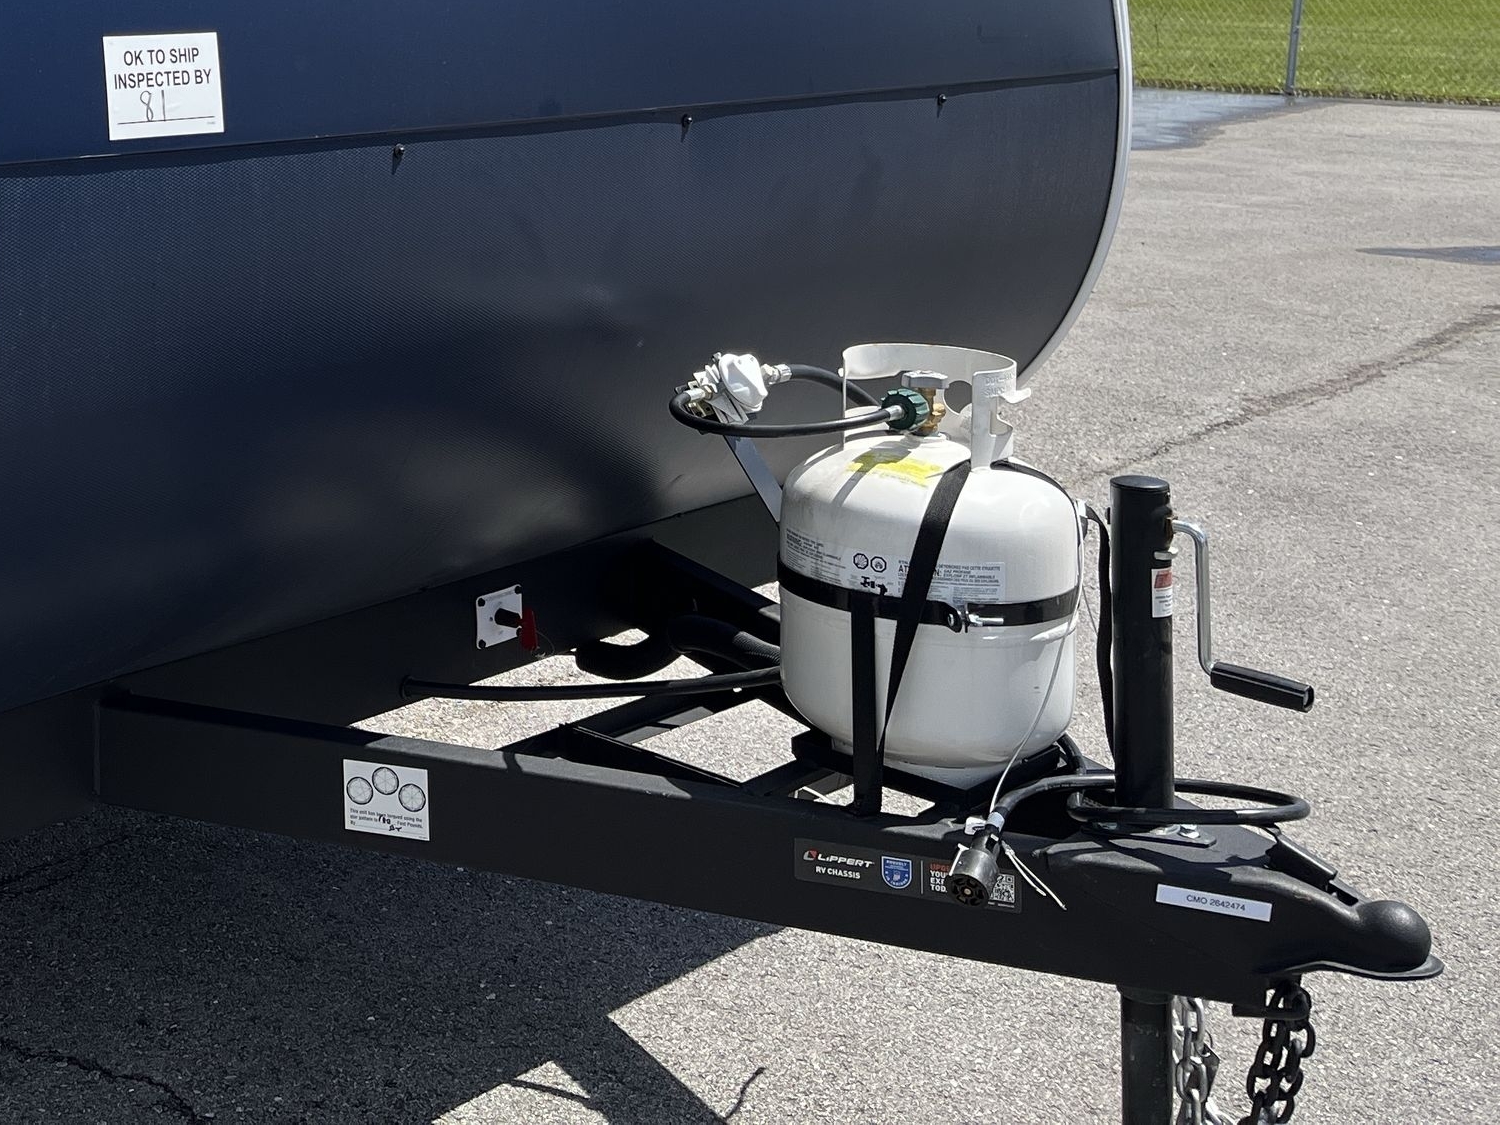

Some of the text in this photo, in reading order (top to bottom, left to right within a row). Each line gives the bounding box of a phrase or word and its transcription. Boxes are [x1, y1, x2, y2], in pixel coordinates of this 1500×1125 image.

[123, 47, 199, 66] OK TO SHIP
[114, 68, 212, 90] INSPECTED BY
[139, 89, 166, 122] 81
[815, 865, 861, 880] RV CHASSIS
[930, 870, 948, 879] YOU
[930, 883, 948, 893] TOD
[1186, 894, 1246, 911] CMO 2642474
